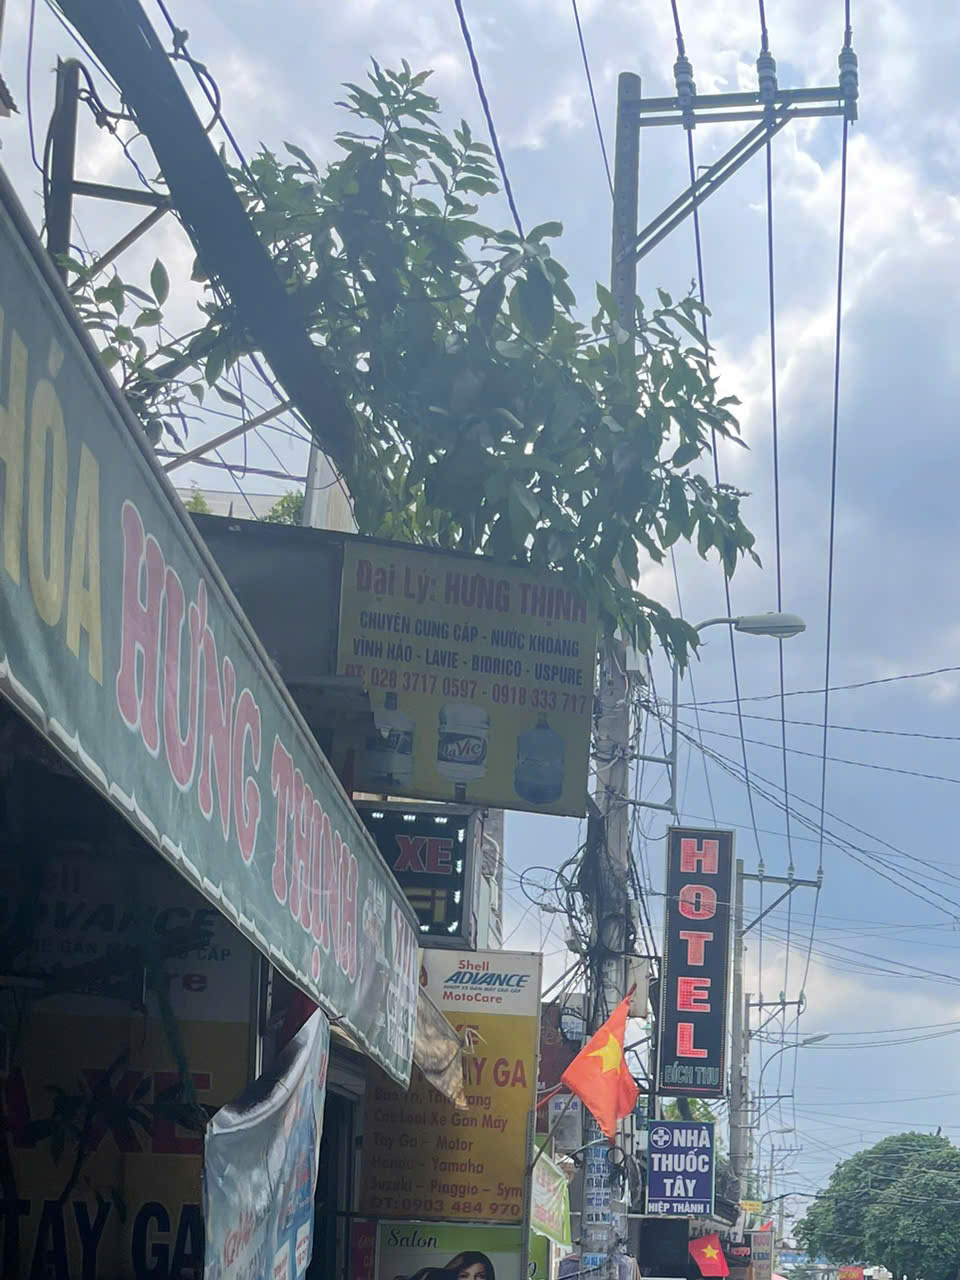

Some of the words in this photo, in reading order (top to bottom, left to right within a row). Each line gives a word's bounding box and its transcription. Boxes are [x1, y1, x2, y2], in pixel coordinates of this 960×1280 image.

[356, 560, 395, 602] Đại
[445, 569, 510, 613] HƯNG
[360, 609, 410, 634] CHUYÊN
[415, 618, 449, 640] CUNG
[490, 627, 525, 650] NƯỚC
[528, 634, 579, 658] KHOÁNG
[425, 648, 459, 670] LAVIE
[471, 654, 521, 677] BIDRICO
[534, 663, 583, 686] USPURE
[371, 667, 397, 688] 028
[402, 671, 438, 695] 3717
[442, 678, 477, 700] 0597
[492, 683, 527, 707] 0918
[531, 690, 557, 712] 333
[562, 693, 587, 715] 717
[116, 499, 262, 866] HƯNG
[271, 735, 360, 986] THỊNH
[394, 833, 454, 875] XE
[676, 838, 719, 1058] HOTEL
[458, 960, 489, 972] Shell
[444, 971, 531, 988] ADVANCE
[443, 991, 503, 1004] MotoCare
[493, 1057, 527, 1089] GA
[664, 1061, 693, 1085] BÍCH
[694, 1066, 720, 1086] THU
[673, 1126, 711, 1148] NHÀ
[431, 1154, 484, 1174] Yamaha
[651, 1148, 710, 1173] THUỐC
[431, 1180, 479, 1198] Piaggio
[496, 1182, 522, 1199] Sym
[663, 1175, 697, 1197] TÂY
[451, 1202, 483, 1214] 484
[488, 1202, 521, 1216] 970
[648, 1200, 670, 1215] HIỆP
[672, 1201, 704, 1213] THÀNH
[387, 1228, 438, 1249] Salon
